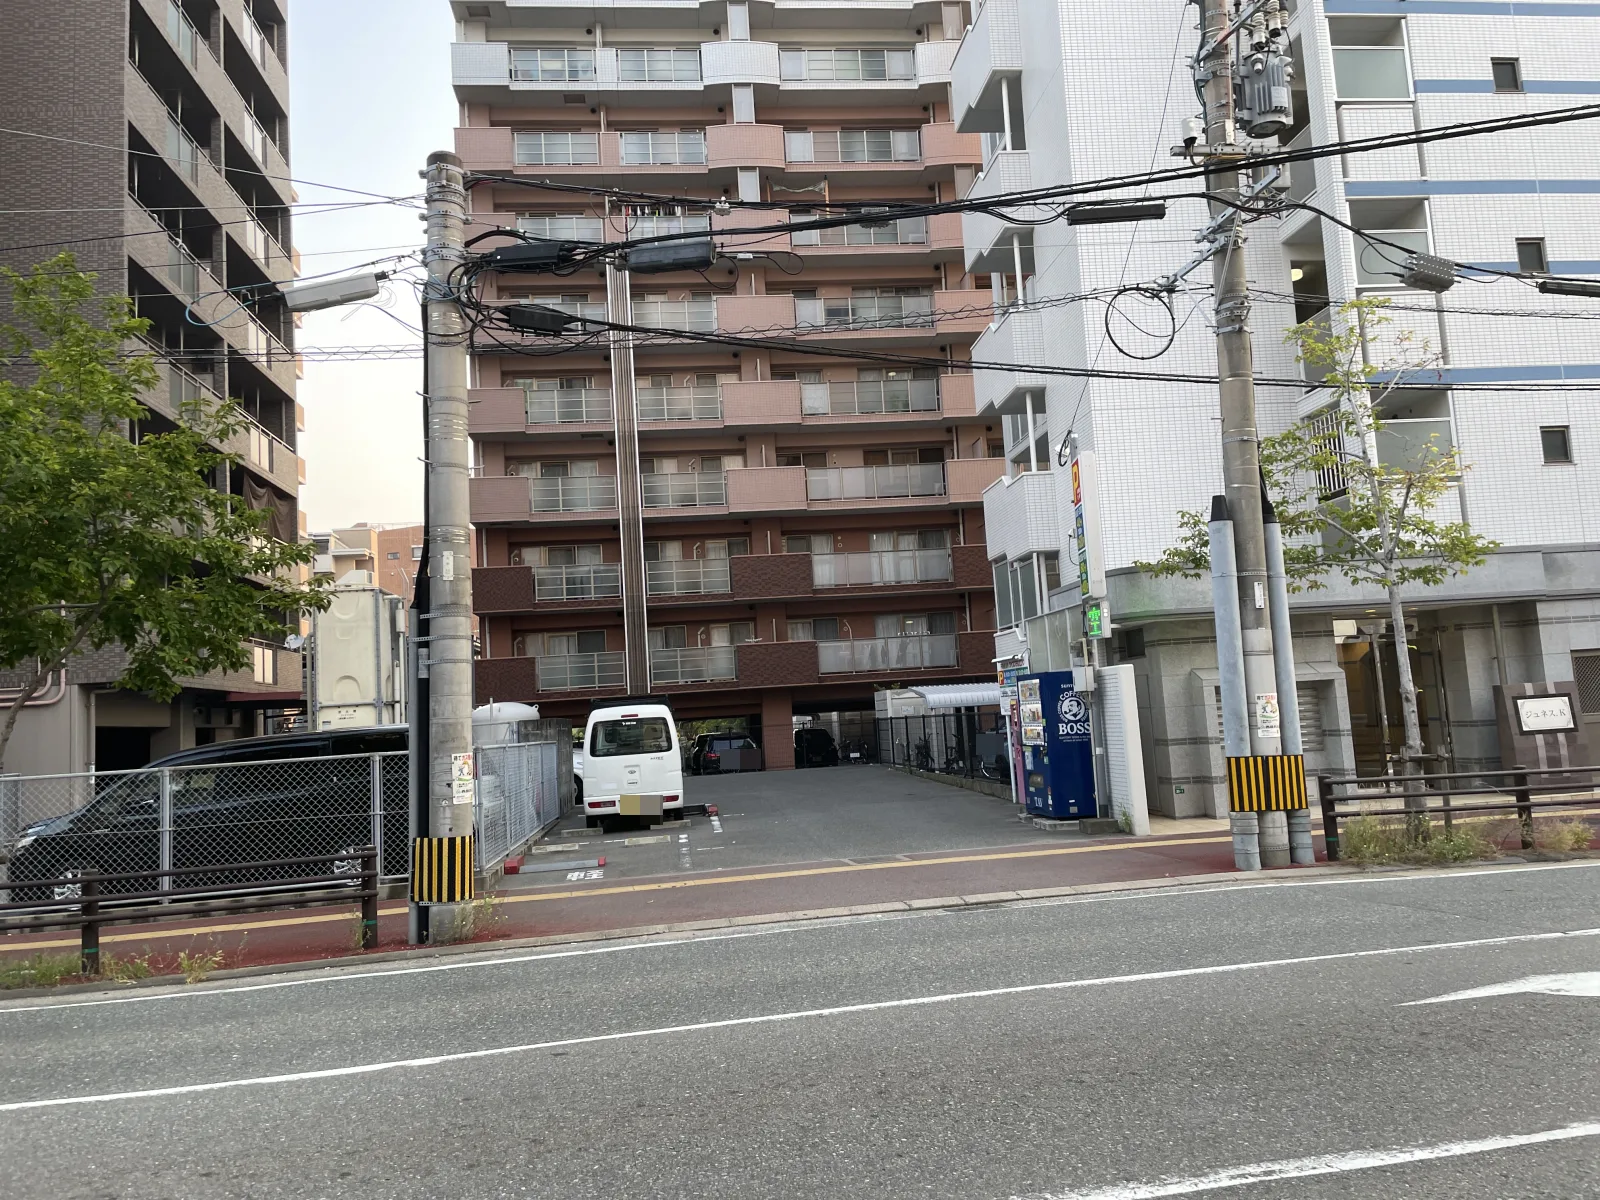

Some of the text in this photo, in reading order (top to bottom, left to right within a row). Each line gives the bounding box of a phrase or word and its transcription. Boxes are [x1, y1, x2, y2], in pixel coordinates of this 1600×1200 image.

[1072, 464, 1080, 503] P
[1088, 606, 1102, 635] 空
[998, 671, 1004, 685] P
[1058, 722, 1091, 735] BOSS
